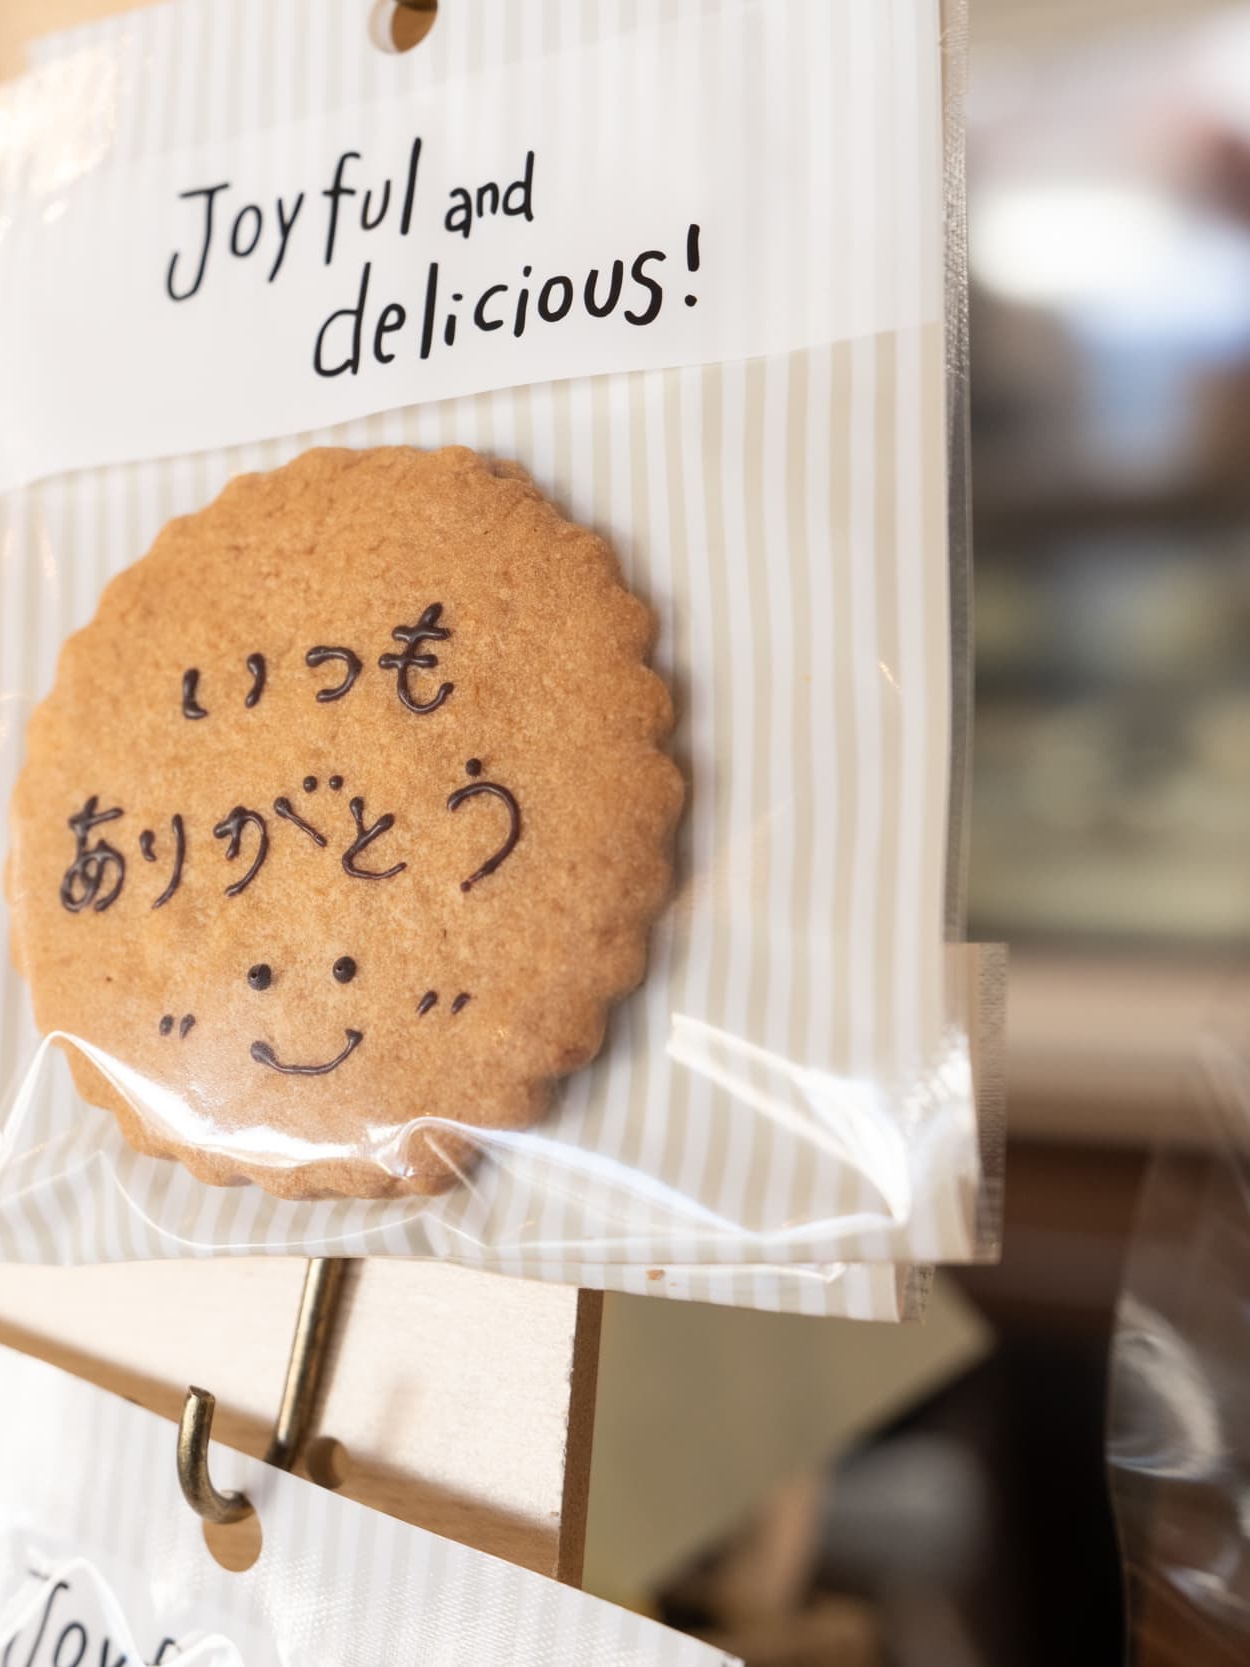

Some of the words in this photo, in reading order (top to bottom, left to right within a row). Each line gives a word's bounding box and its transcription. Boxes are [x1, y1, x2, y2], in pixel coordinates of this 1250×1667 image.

[165, 135, 424, 303] Joyful
[443, 149, 536, 240] and
[312, 222, 702, 379] delicious!
[181, 601, 456, 720] いつも
[60, 757, 524, 912] ありがとう
